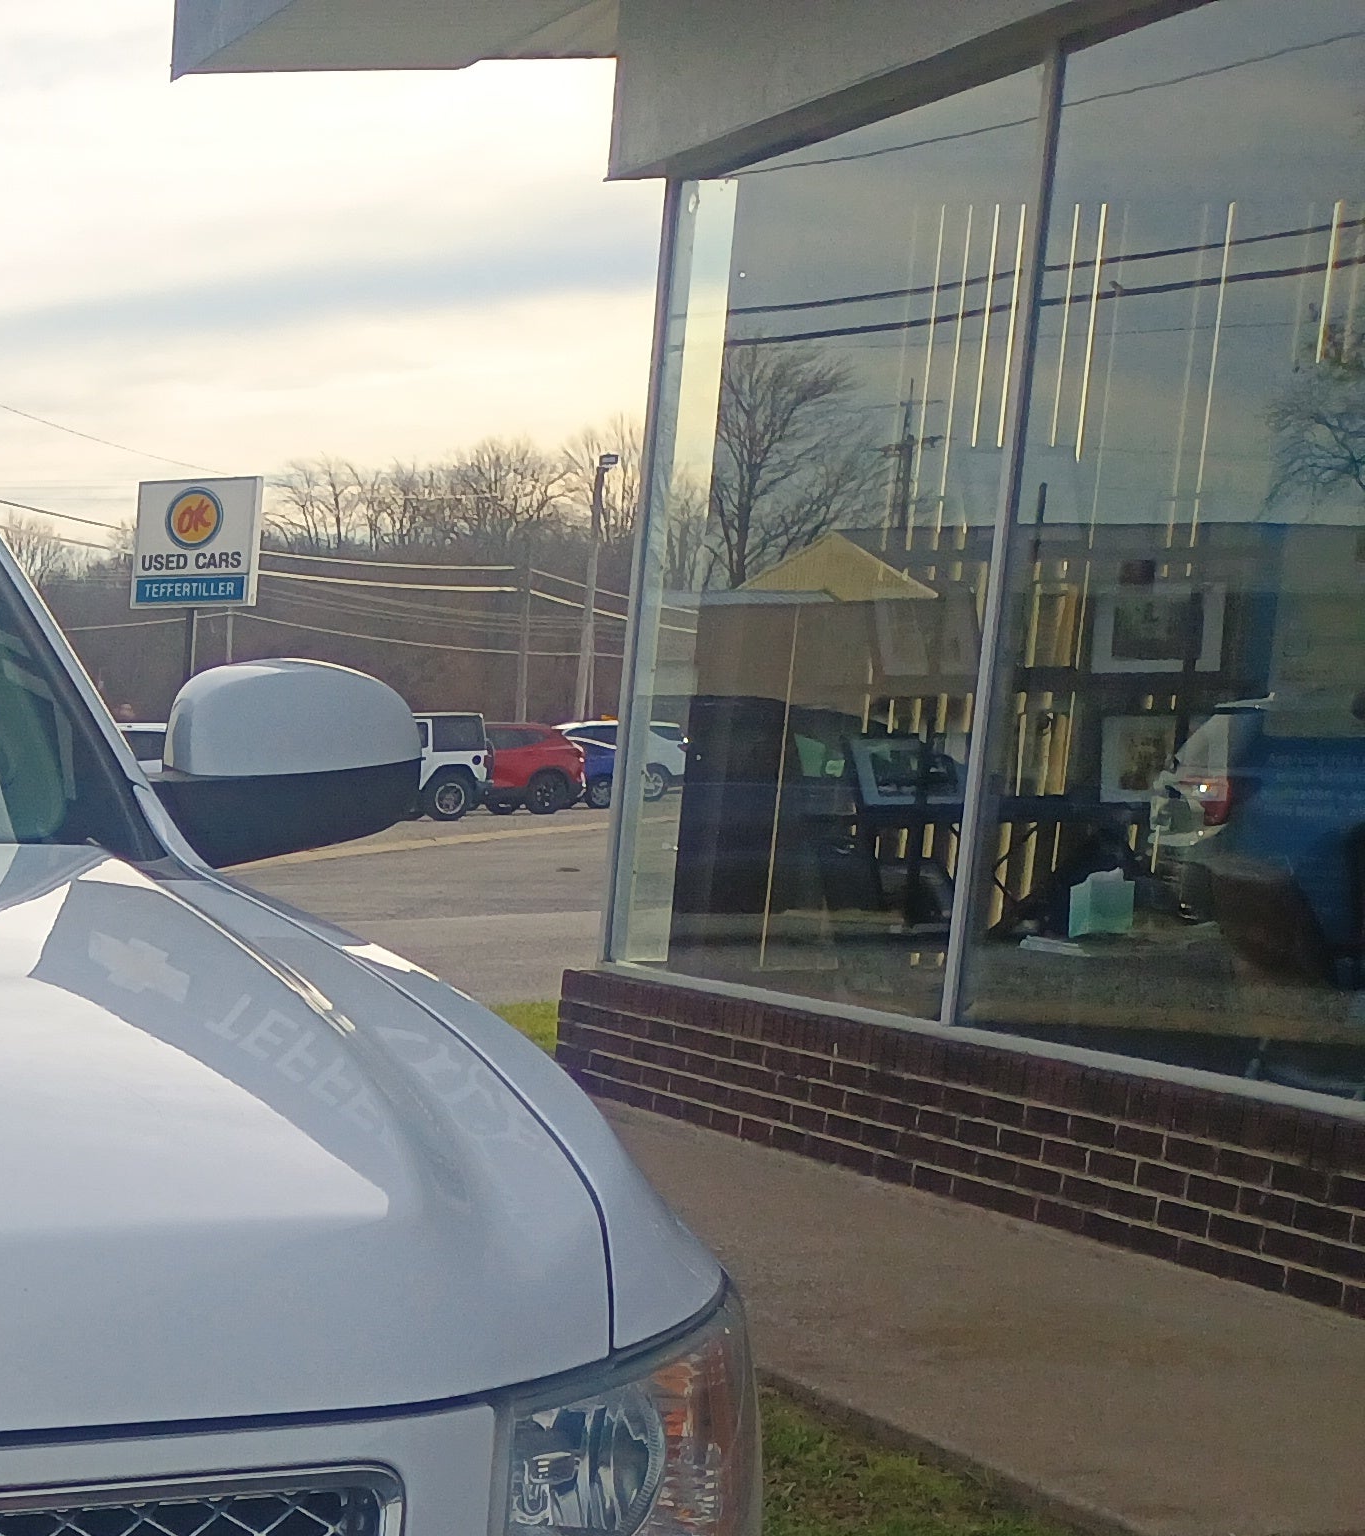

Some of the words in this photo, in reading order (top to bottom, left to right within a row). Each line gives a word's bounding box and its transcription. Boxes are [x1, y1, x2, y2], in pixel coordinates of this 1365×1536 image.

[177, 499, 211, 534] OK
[141, 553, 188, 571] USED
[195, 551, 242, 570] CARS
[145, 581, 235, 598] TEFFERTILLER
